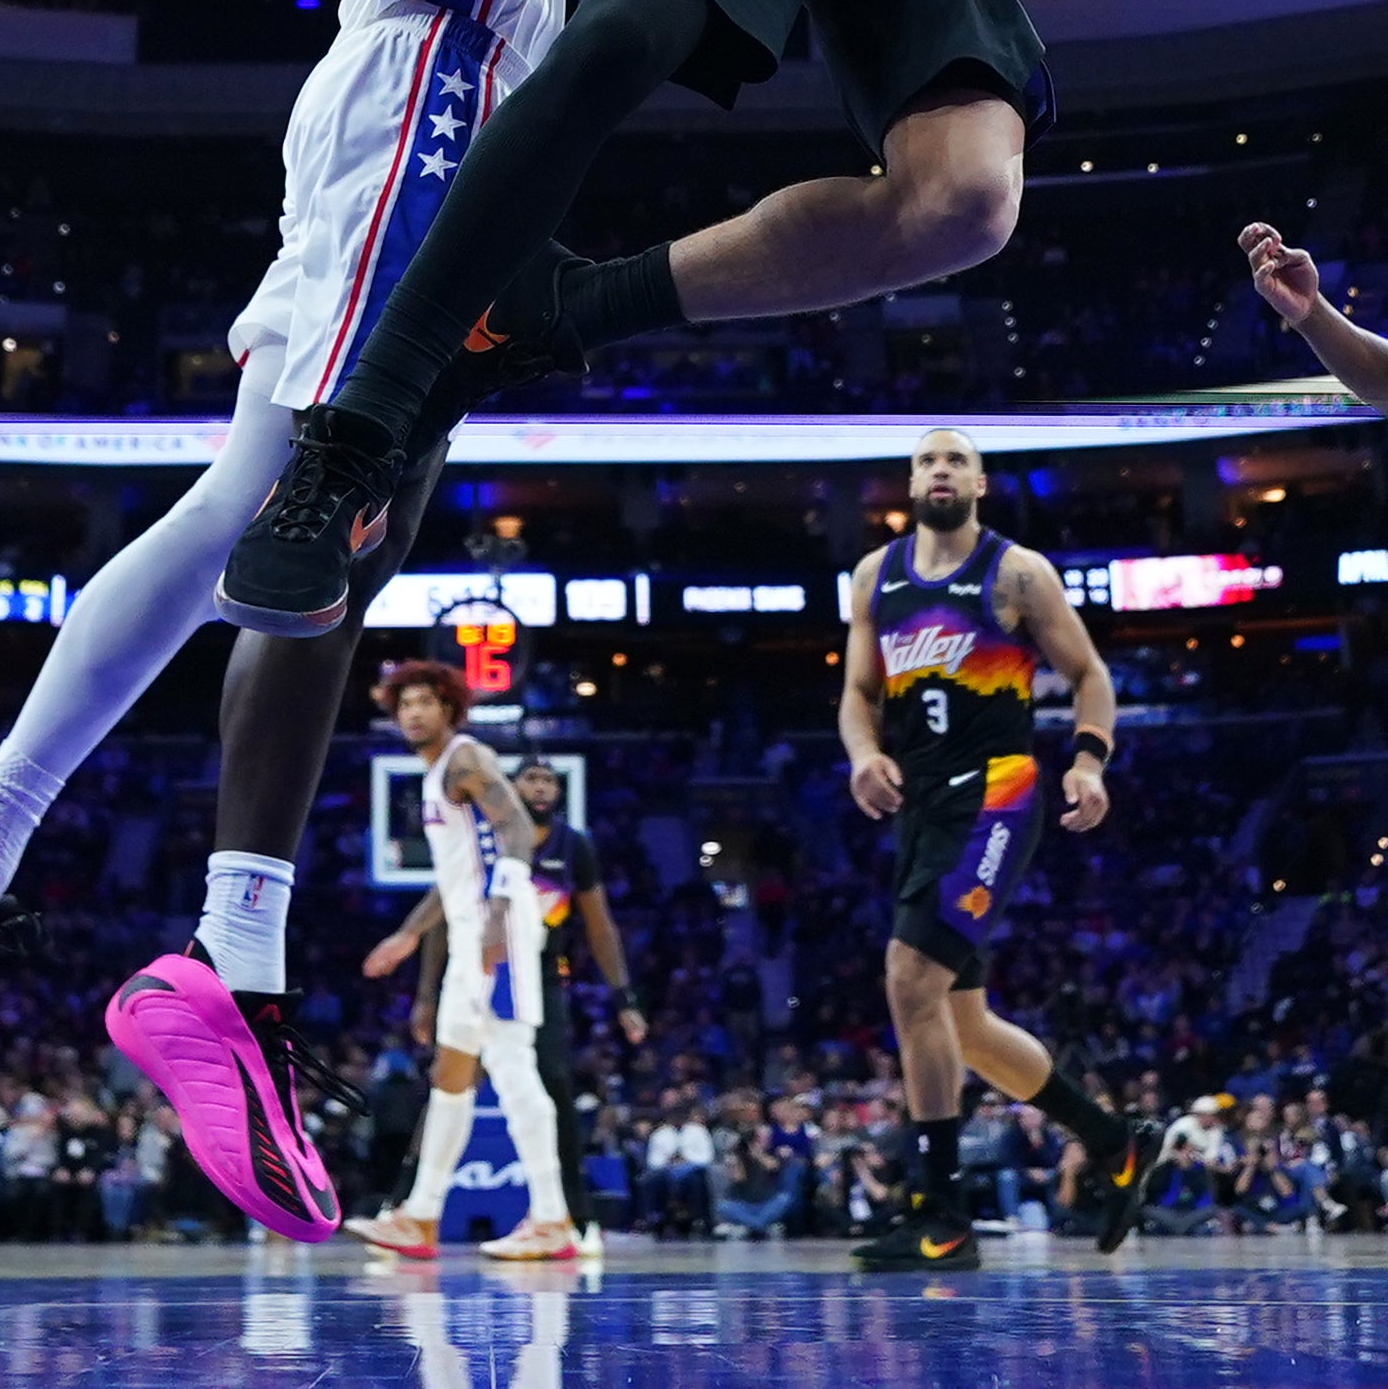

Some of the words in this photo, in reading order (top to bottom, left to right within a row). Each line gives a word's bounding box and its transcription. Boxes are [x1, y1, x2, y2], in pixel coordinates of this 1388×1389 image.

[948, 583, 982, 596] PayPal
[466, 642, 511, 691] 16
[880, 625, 977, 678] Valley
[922, 689, 949, 734] 3
